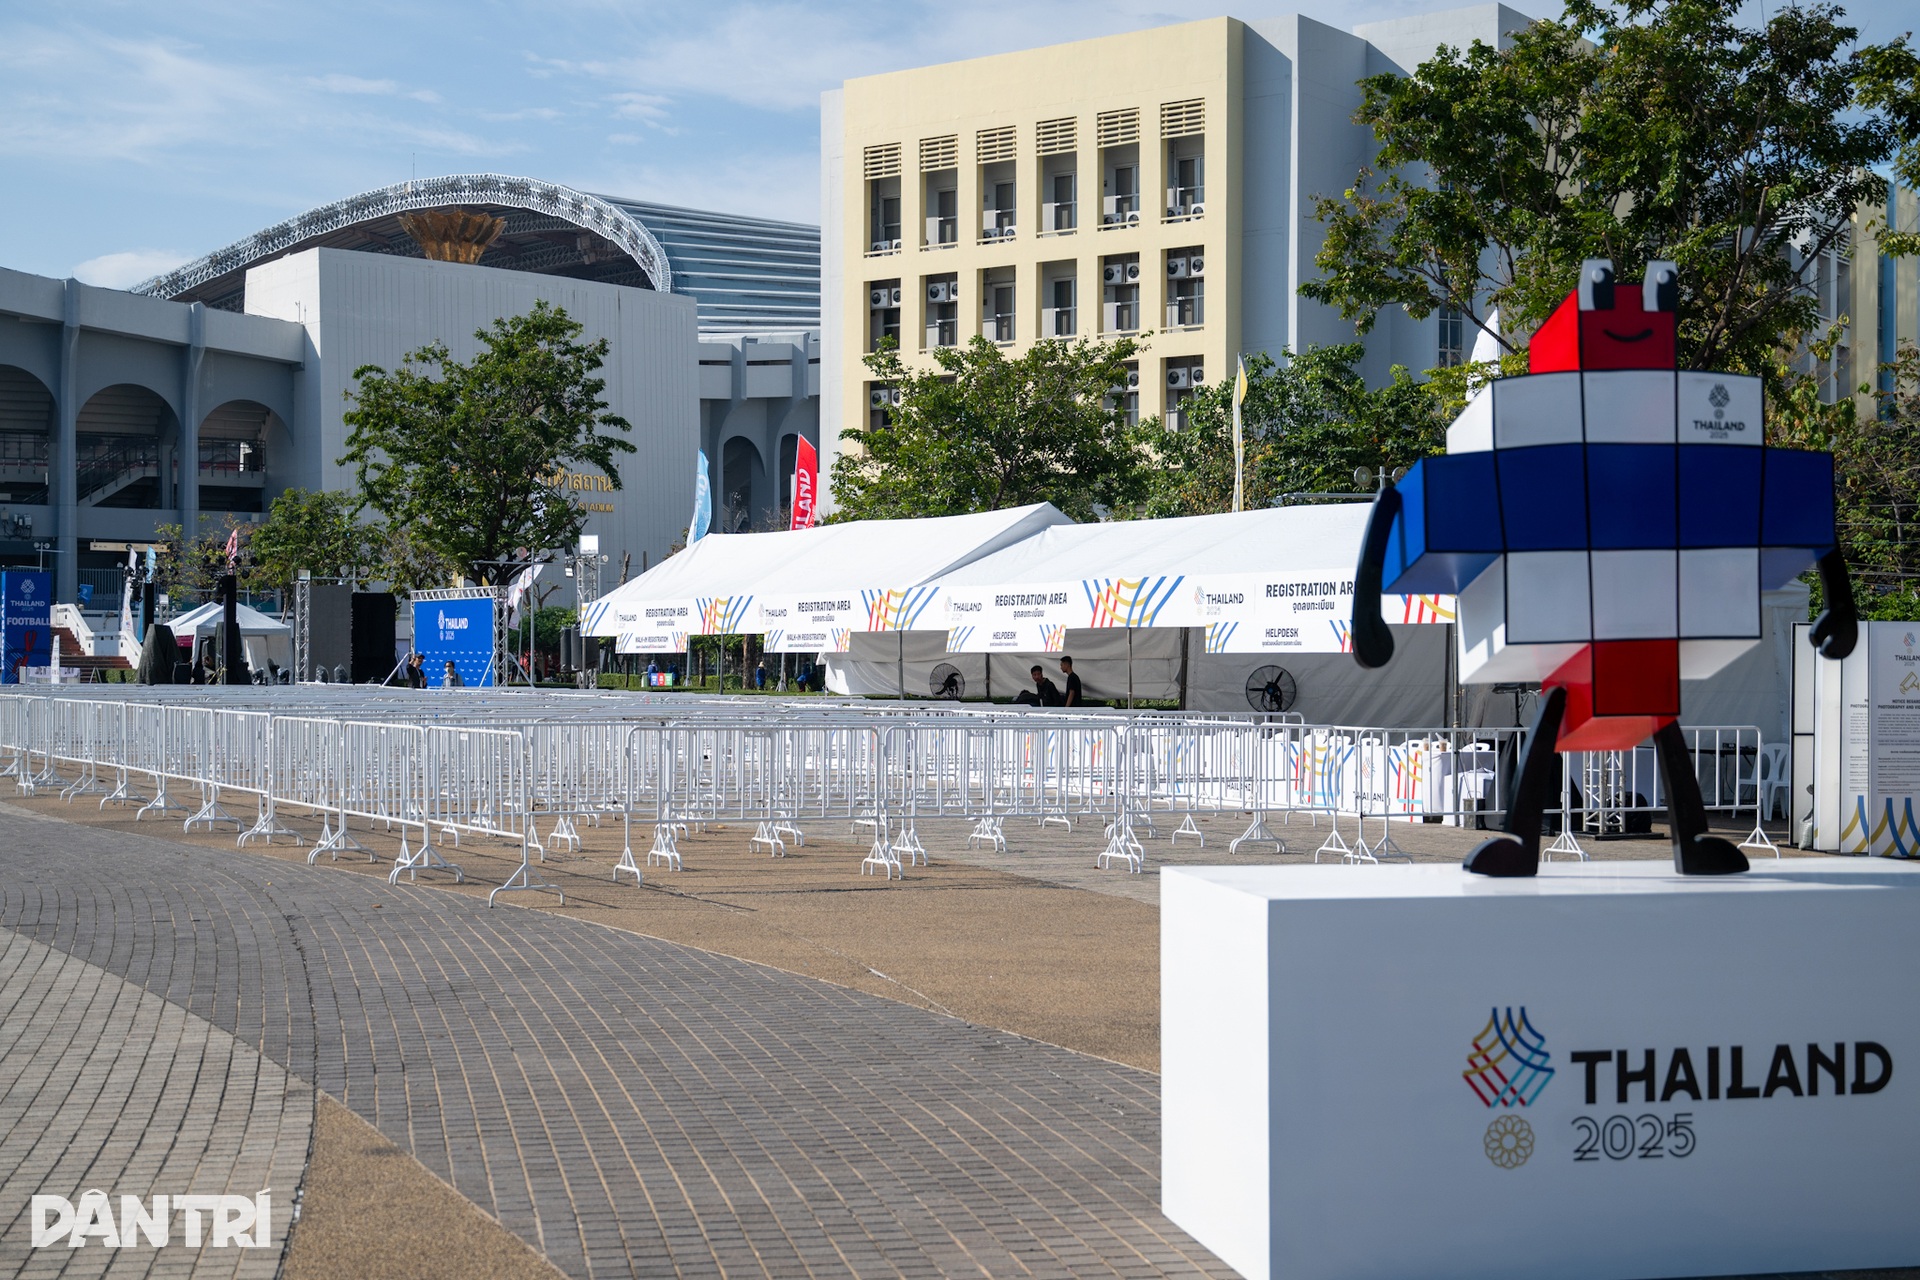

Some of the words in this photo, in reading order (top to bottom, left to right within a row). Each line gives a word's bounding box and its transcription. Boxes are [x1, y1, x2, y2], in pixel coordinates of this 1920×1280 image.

[1693, 420, 1746, 431] THAILAND
[578, 502, 614, 513] STADIUM
[1266, 581, 1337, 598] REGISTRATION
[1339, 581, 1354, 595] AR
[995, 594, 1047, 606] REGISTRATION
[1049, 592, 1067, 604] AREA
[1206, 593, 1245, 605] THAILAND
[797, 601, 836, 612] REGISTRATION
[837, 600, 851, 610] AREA
[953, 603, 982, 612] THAILAND
[1293, 599, 1335, 613] จุดลงทะเบียน
[619, 614, 638, 622] THAILAND
[645, 608, 677, 618] REGISTRATION
[677, 607, 688, 616] AREA
[765, 608, 788, 618] THAILAND
[6, 617, 51, 626] FOOTBALL
[445, 618, 468, 629] THAILAND
[992, 631, 1017, 640] HELPDESK
[1265, 627, 1299, 638] HELPDESK
[1571, 1041, 1893, 1104] THAILAND
[1571, 1113, 1696, 1161] 2025
